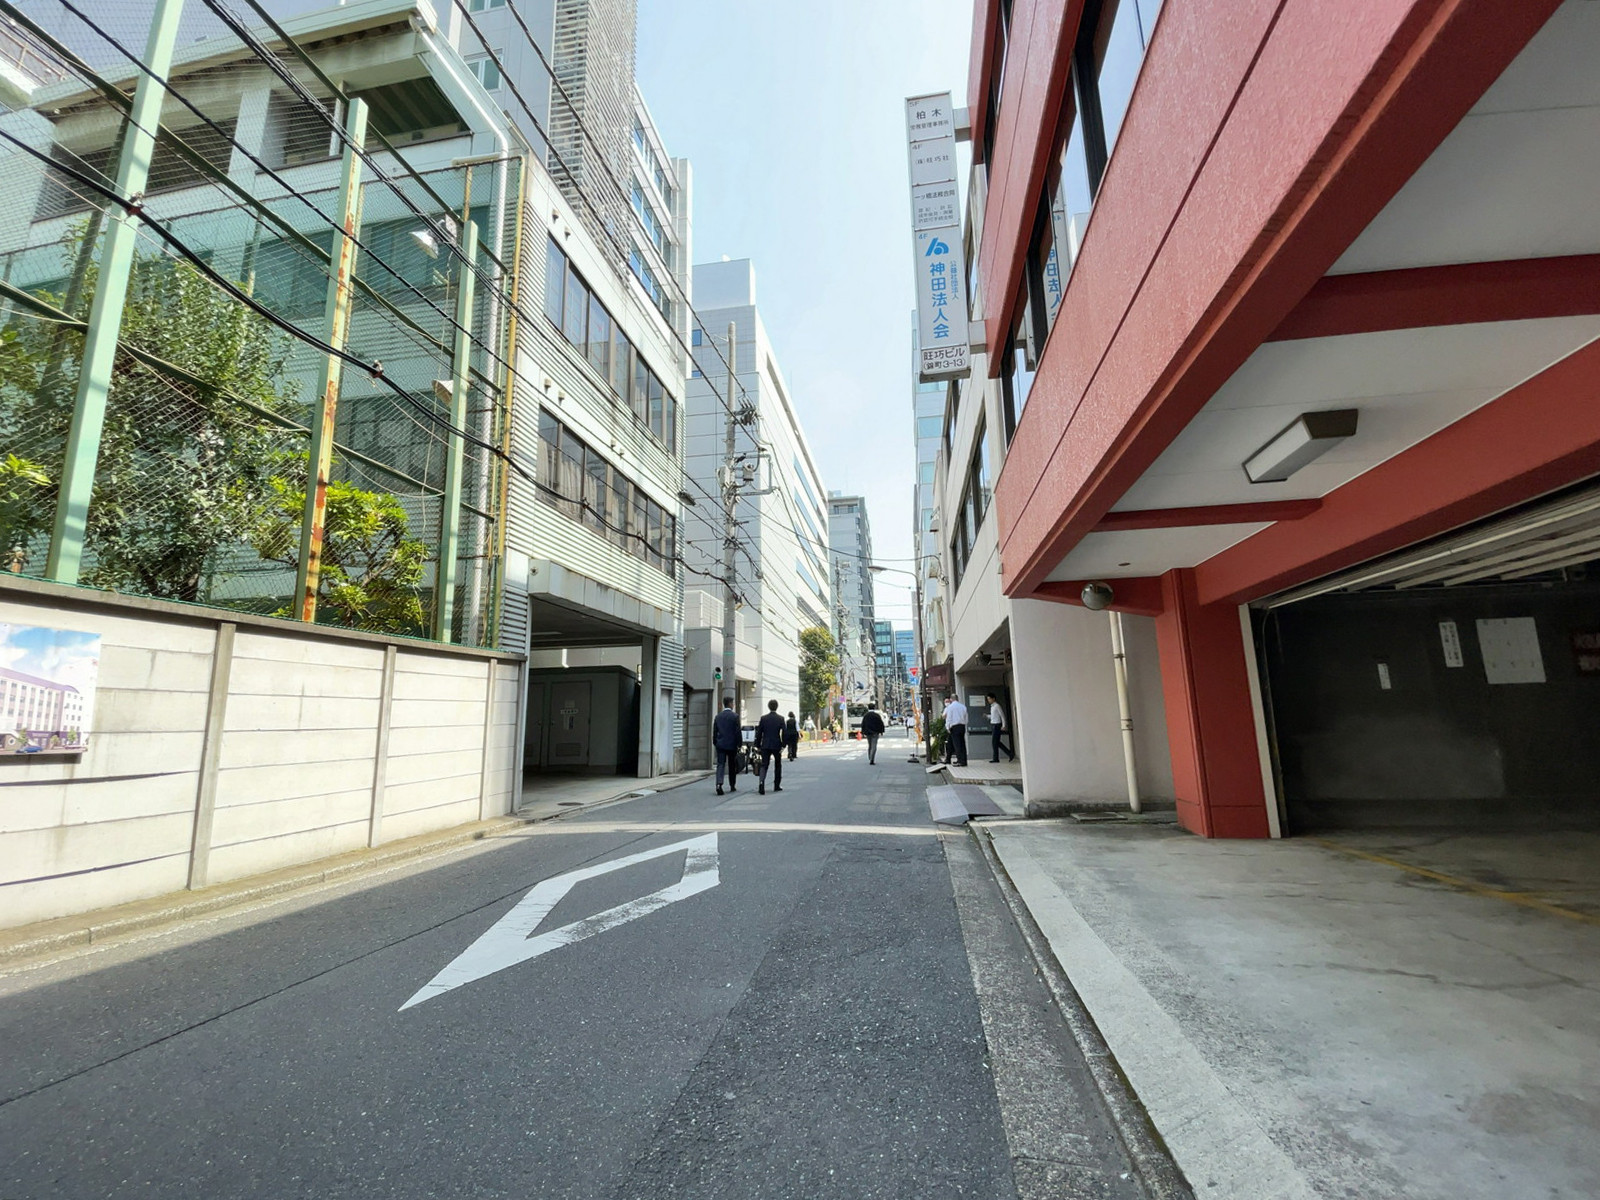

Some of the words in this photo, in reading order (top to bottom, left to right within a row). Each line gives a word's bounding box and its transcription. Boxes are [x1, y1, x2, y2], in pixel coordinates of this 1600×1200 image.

[916, 108, 942, 119] 柏木
[929, 262, 950, 339] 神田法人会
[923, 347, 966, 361] 旺巧ビル
